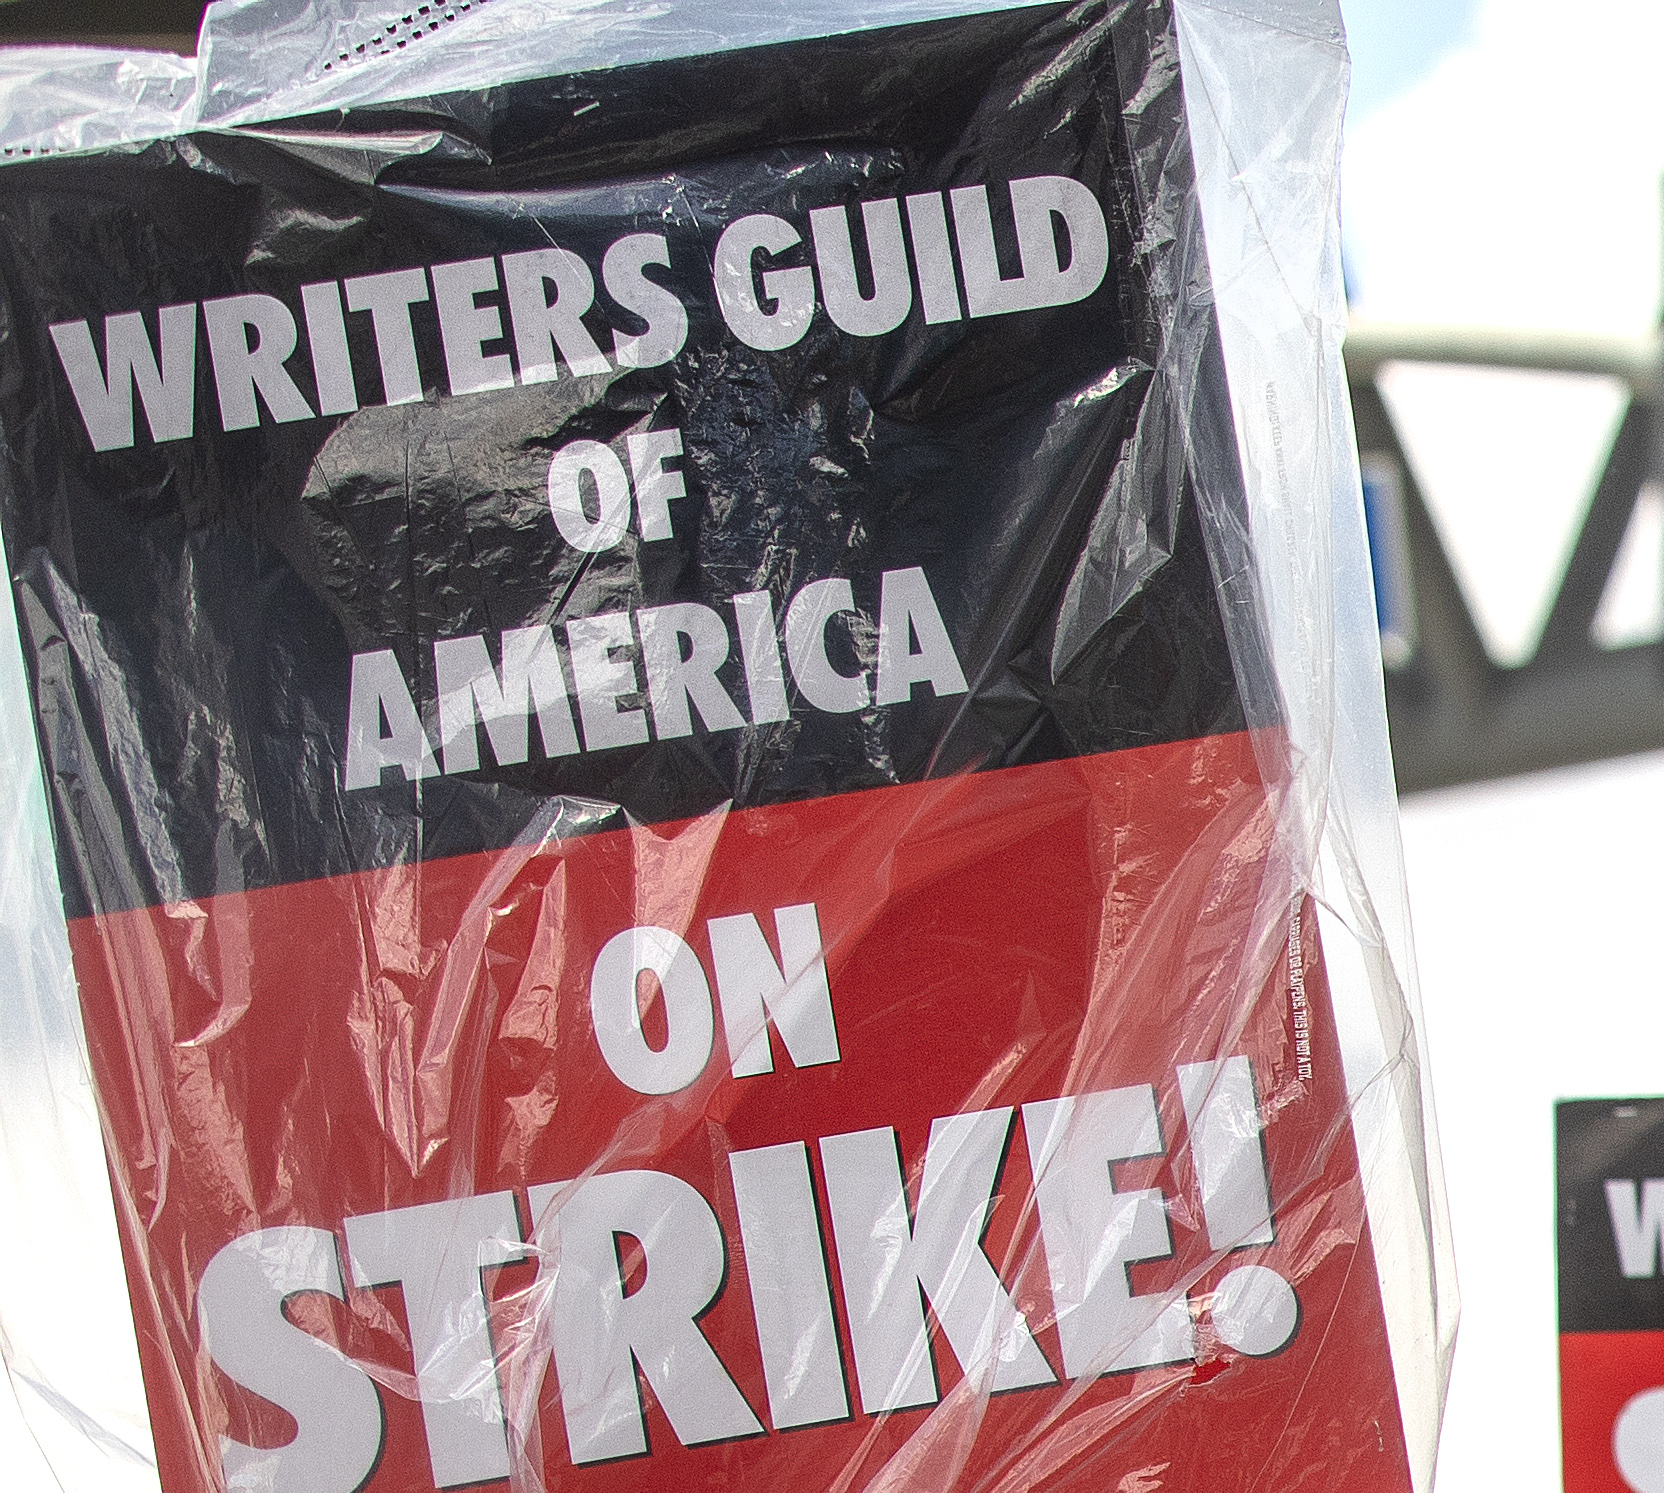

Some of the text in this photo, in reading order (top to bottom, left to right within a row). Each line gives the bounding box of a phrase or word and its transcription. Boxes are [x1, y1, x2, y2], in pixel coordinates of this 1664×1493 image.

[49, 174, 1111, 453] WRITERS GUILD
[546, 427, 688, 554] OF
[344, 565, 970, 793] AMERICA
[589, 901, 842, 1096] ON
[1294, 1010, 1307, 1028] THIS
[1296, 1039, 1309, 1055] NOT
